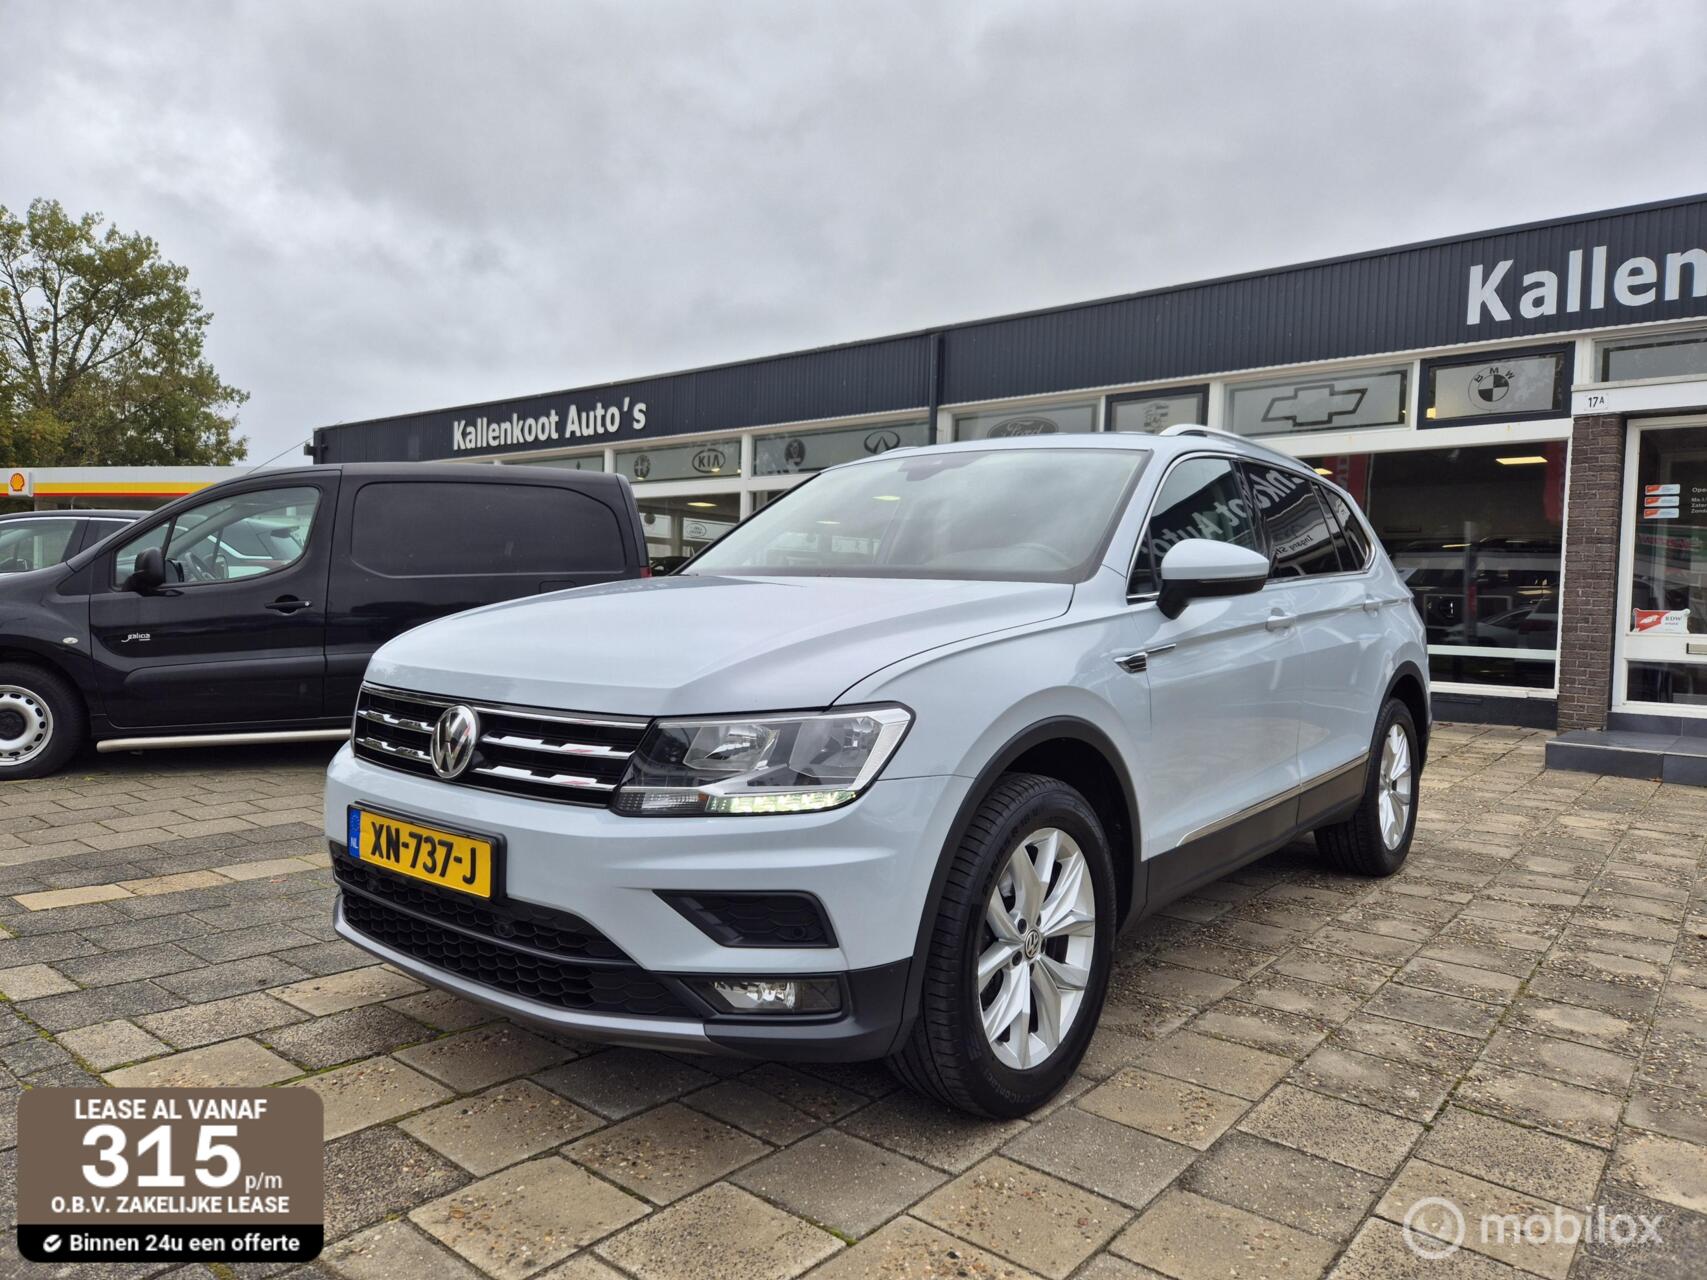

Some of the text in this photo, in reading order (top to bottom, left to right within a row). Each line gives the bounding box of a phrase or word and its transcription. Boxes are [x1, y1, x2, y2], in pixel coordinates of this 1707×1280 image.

[1467, 246, 1707, 325] Kallen
[1474, 367, 1515, 383] BMW
[454, 397, 647, 450] Kallenkoot Auto's
[698, 454, 720, 468] KIA
[371, 821, 477, 886] XN-737-J
